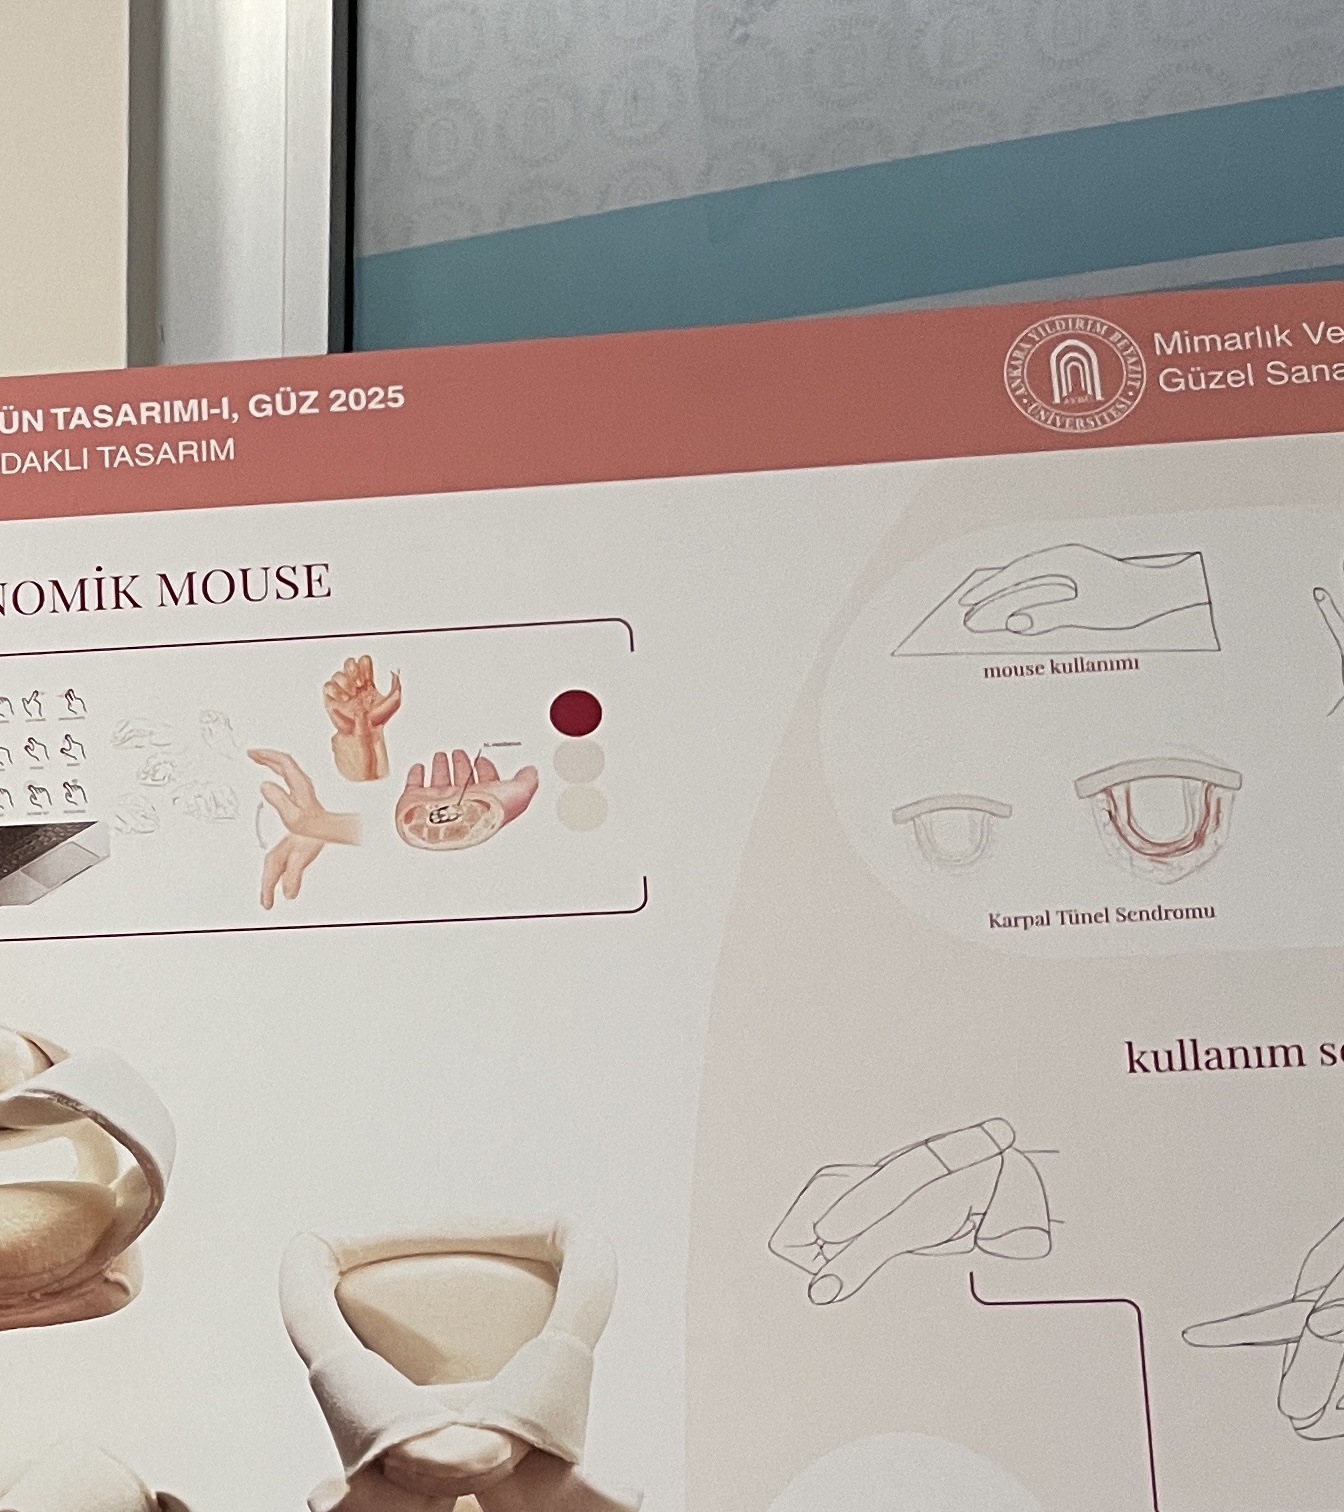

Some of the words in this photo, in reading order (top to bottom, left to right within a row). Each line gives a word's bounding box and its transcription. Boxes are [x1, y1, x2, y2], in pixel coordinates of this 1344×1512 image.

[1028, 317, 1109, 341] YILDIRIM
[1153, 324, 1293, 356] Mimarlık
[1302, 321, 1344, 345] Ve
[1158, 363, 1255, 393] Güzel
[50, 397, 239, 431] TASARIMI-I,
[248, 386, 320, 419] GÜZ
[330, 384, 405, 414] 2025
[97, 437, 236, 468] TASARIM
[157, 562, 332, 608] MOUSE
[983, 664, 1045, 679] mouse
[1049, 656, 1140, 675] kullanımı
[988, 910, 1051, 931] Karpal
[1056, 907, 1110, 926] Tünel
[1115, 905, 1216, 923] Sendromu
[1124, 1038, 1307, 1074] kullanım
[1319, 1042, 1344, 1067] s
